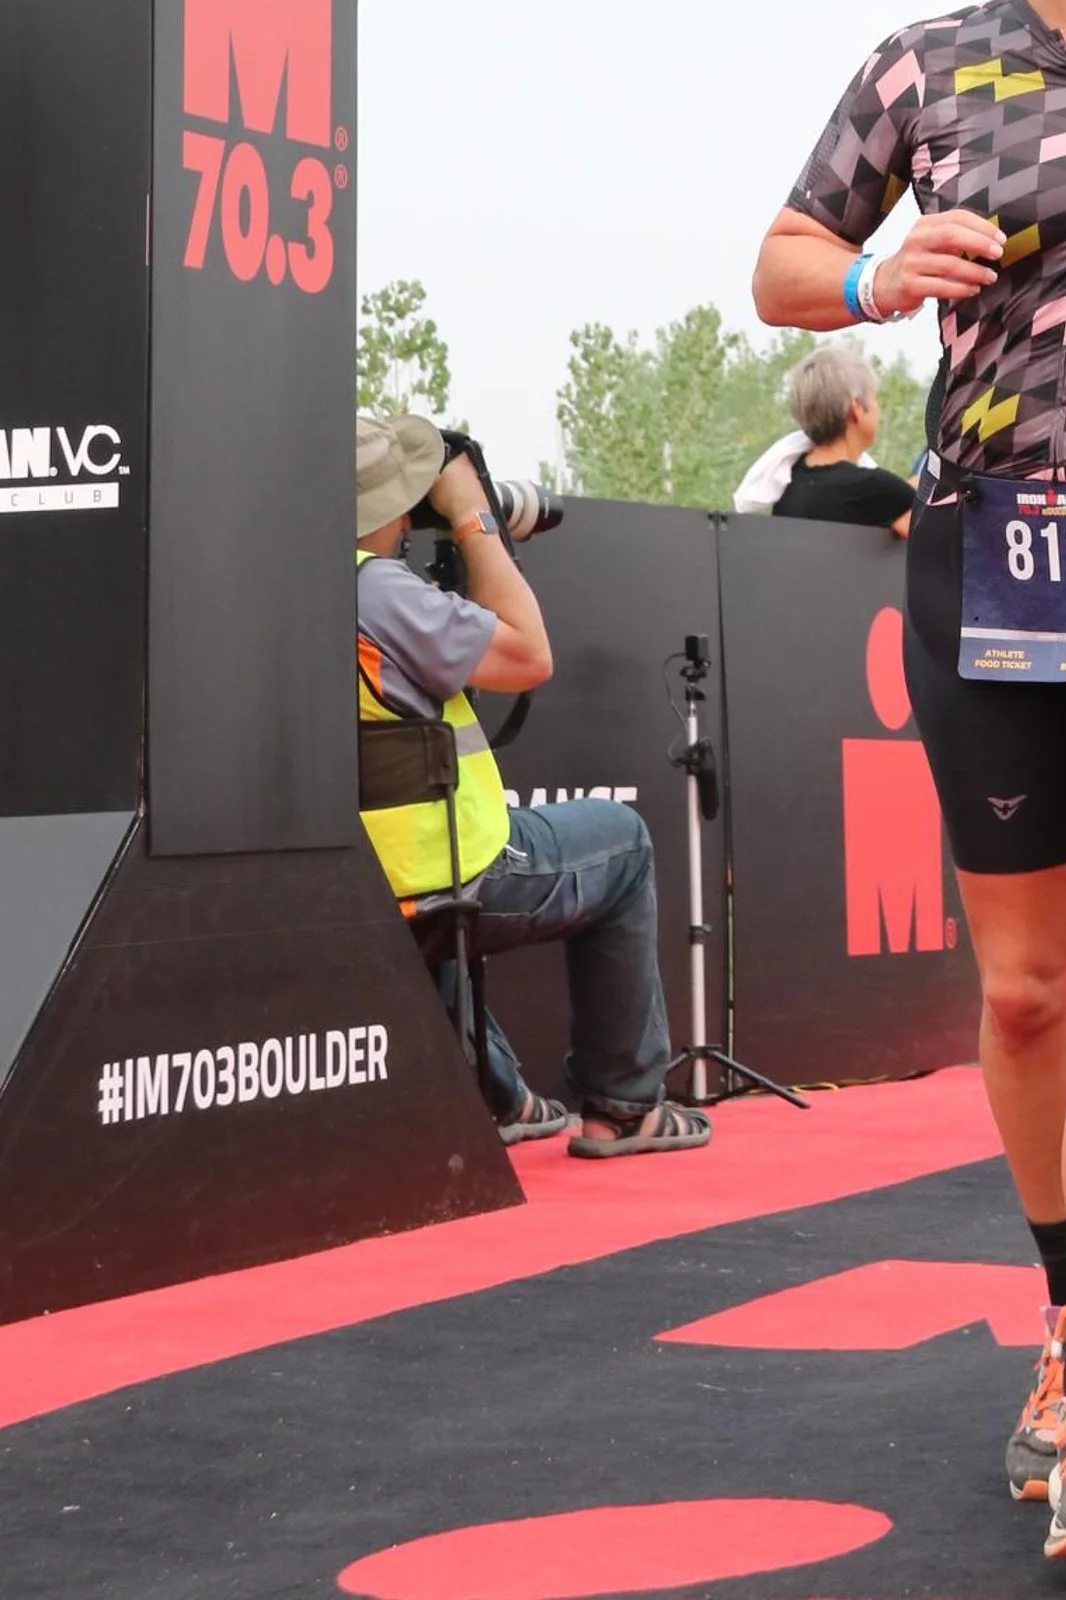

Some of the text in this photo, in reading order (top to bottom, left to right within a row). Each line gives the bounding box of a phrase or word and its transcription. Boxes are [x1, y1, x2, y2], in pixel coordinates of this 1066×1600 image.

[183, 128, 334, 293] 70.3
[11, 489, 102, 506] CLUB
[984, 649, 1025, 660] ATHLETE
[974, 659, 1032, 671] FOOD TICKET
[97, 1024, 389, 1125] #IM703BOULDER
